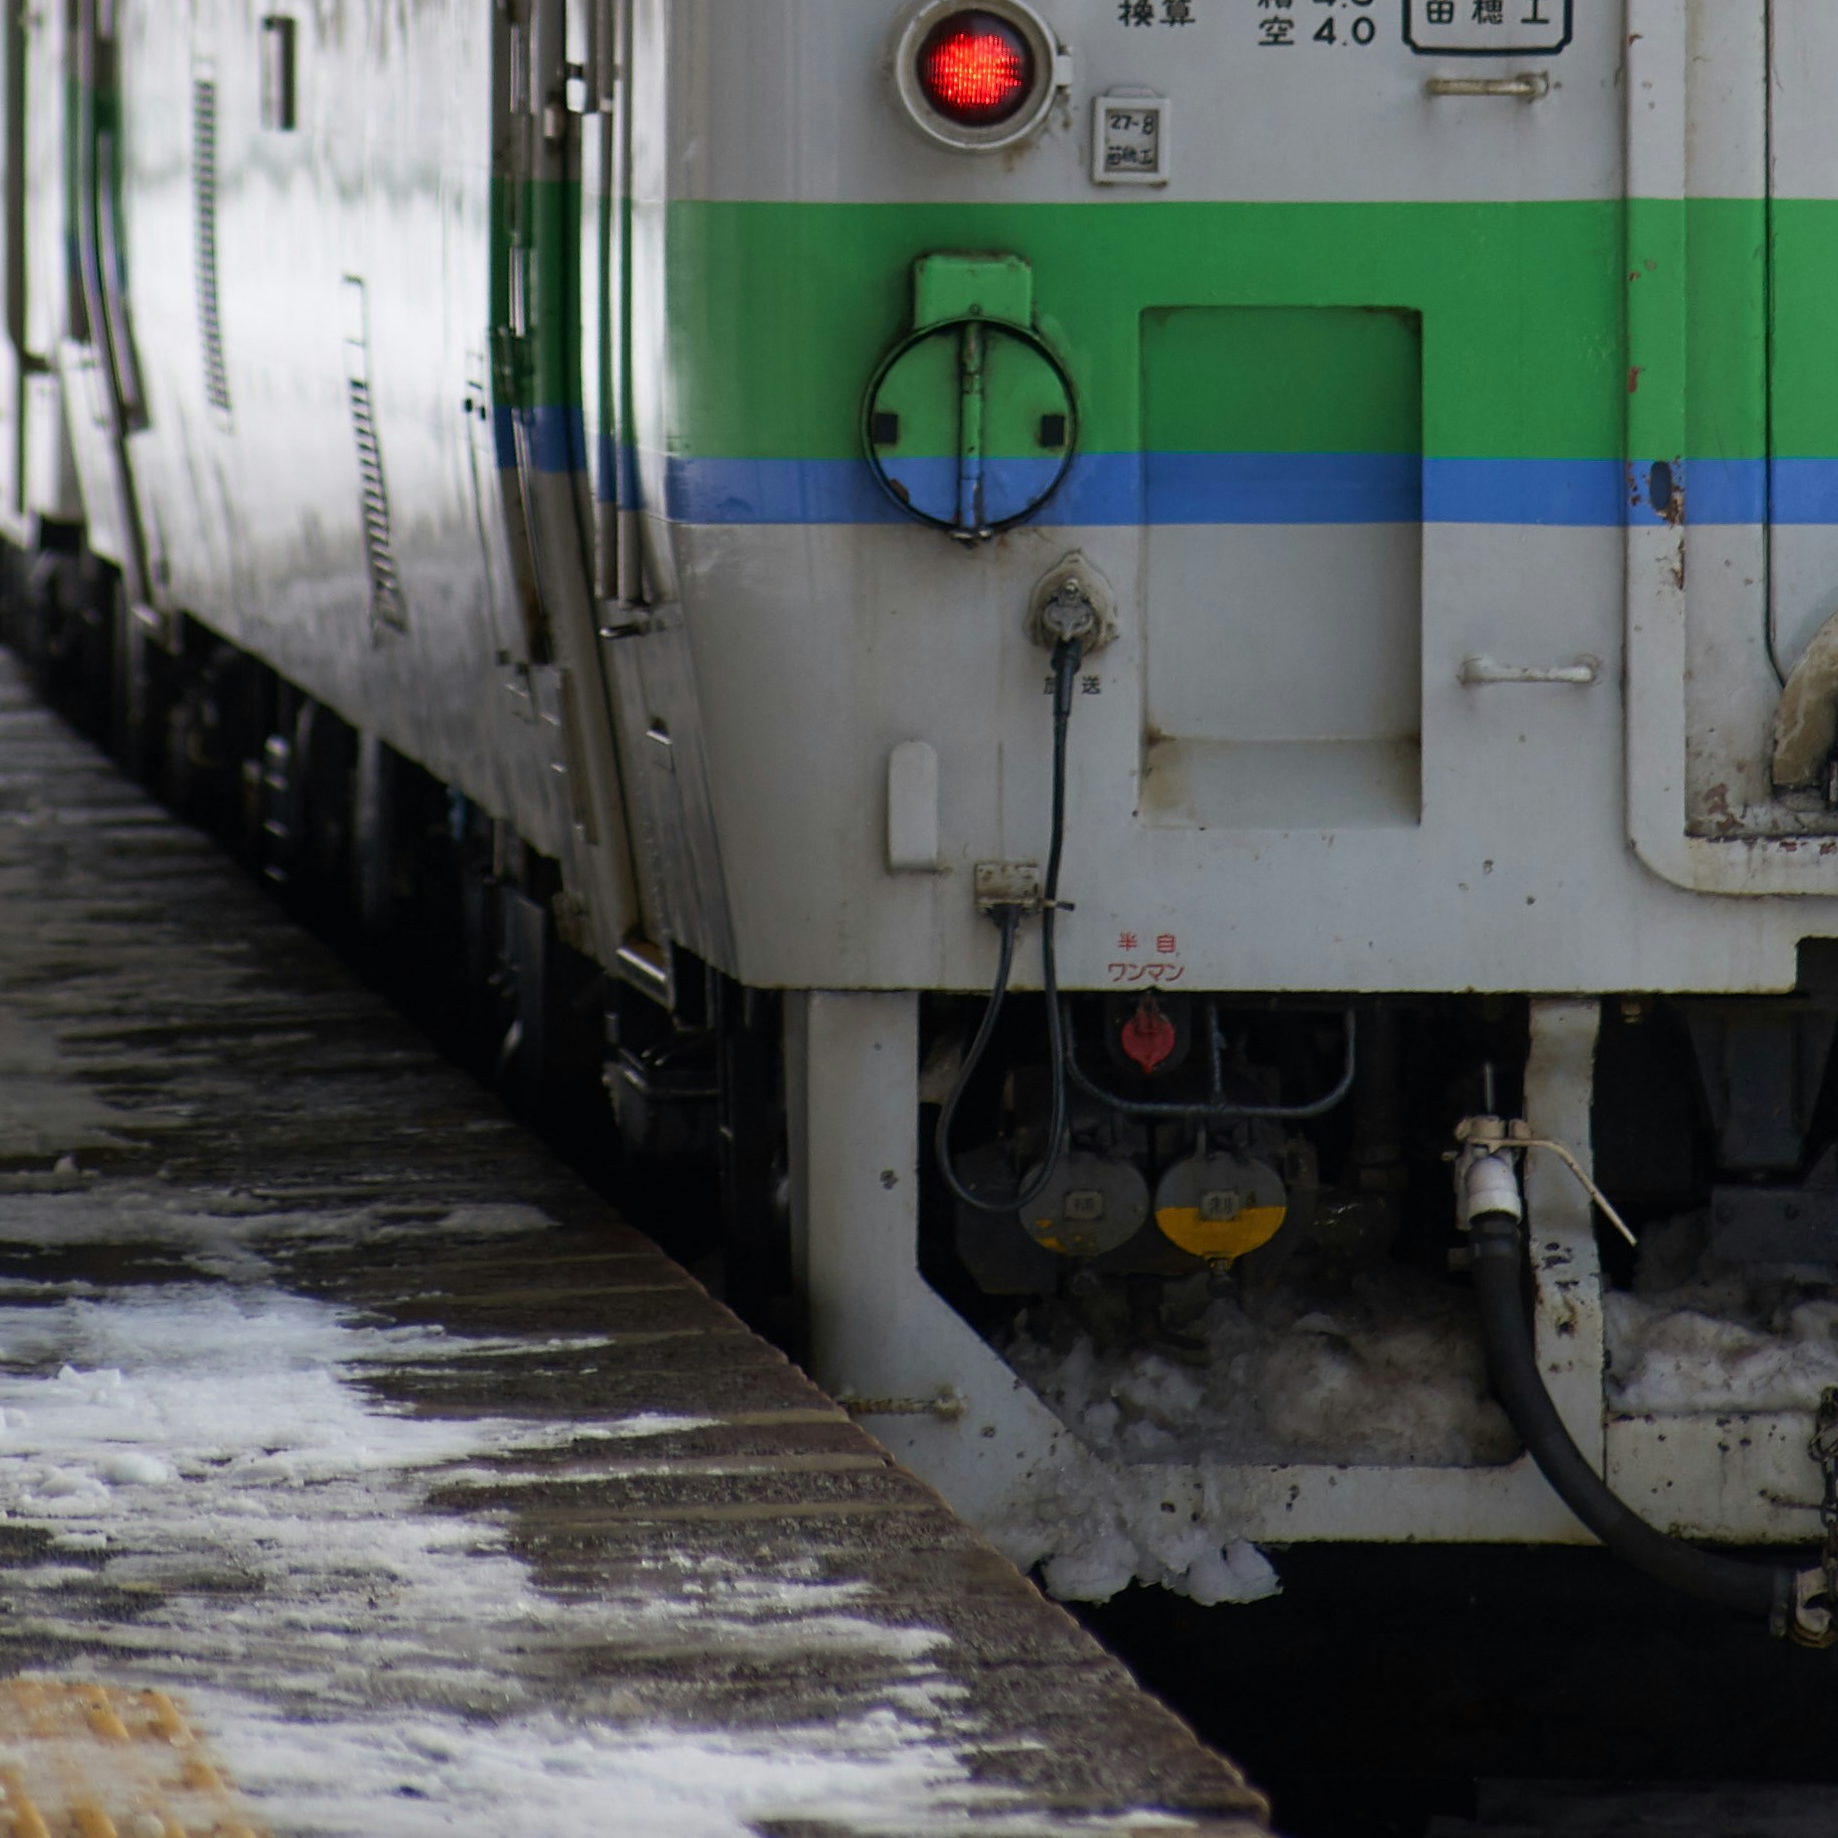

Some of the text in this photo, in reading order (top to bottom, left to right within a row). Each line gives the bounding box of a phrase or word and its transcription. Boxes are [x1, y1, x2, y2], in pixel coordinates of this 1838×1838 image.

[1258, 15, 1376, 46] 空 4.0
[1118, 931, 1176, 954] 半自
[1108, 962, 1185, 982] ワンマン
